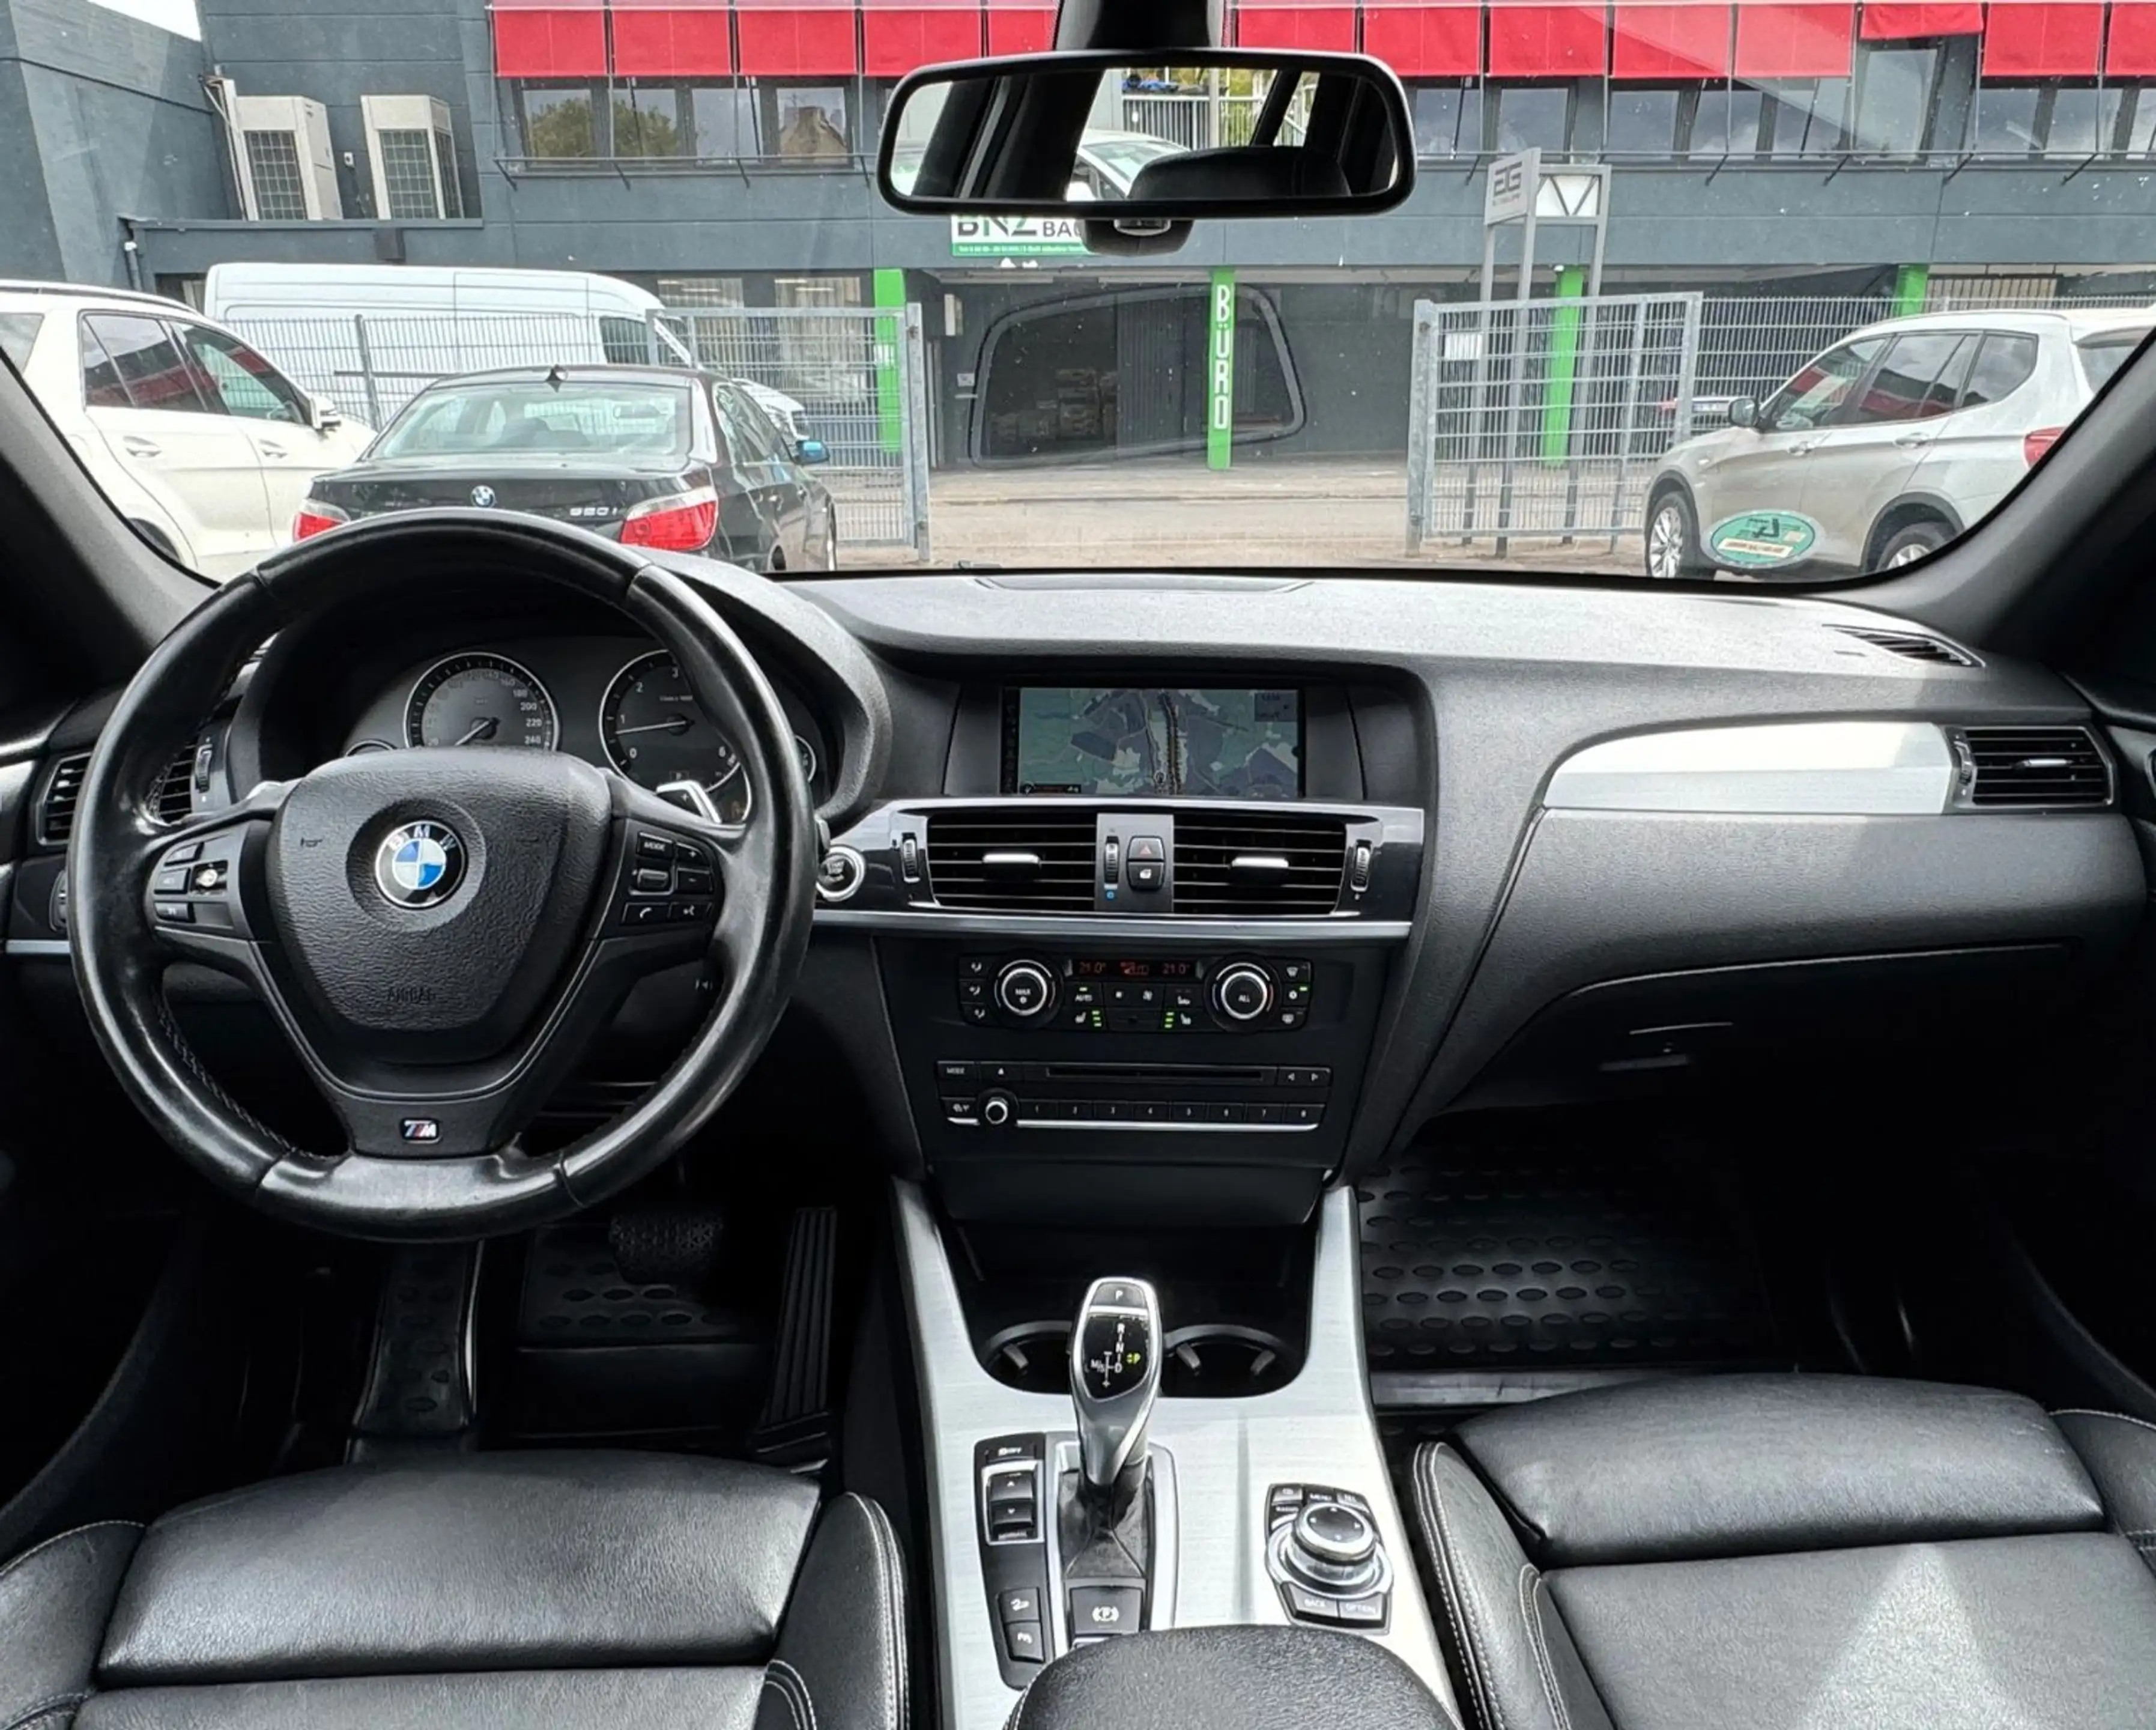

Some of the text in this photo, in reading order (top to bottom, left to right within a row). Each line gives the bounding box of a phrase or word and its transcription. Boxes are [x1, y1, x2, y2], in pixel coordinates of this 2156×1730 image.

[1214, 284, 1230, 429] BÜRO
[671, 668, 679, 678] 3
[636, 682, 644, 693] 2
[521, 702, 537, 711] 200
[526, 718, 542, 727] 220
[620, 715, 626, 724] 1
[525, 736, 542, 745] 240
[629, 748, 637, 759] 0
[389, 824, 458, 852] BMW
[1115, 1290, 1124, 1301] P
[1115, 1342, 1124, 1352] N
[1114, 1362, 1122, 1373] D
